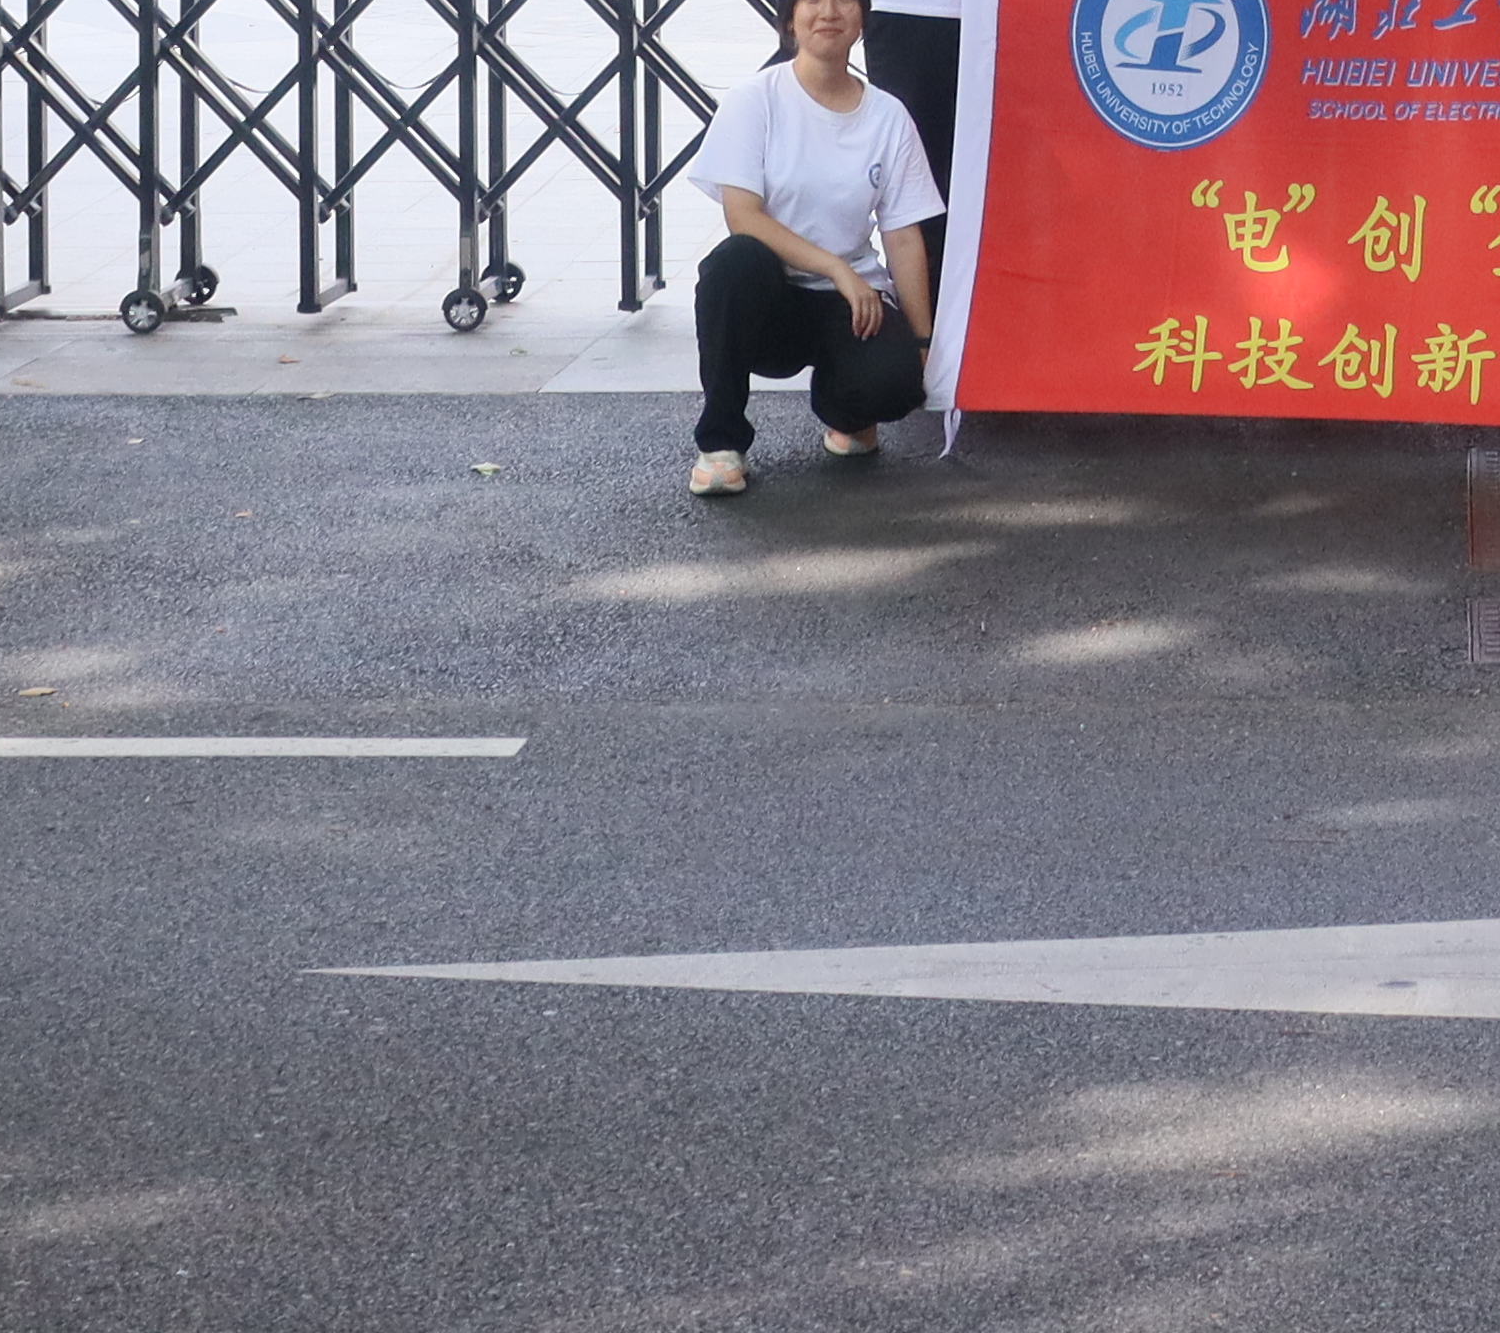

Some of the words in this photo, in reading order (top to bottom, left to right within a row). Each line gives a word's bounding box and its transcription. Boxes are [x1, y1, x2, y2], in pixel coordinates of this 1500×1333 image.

[1080, 31, 1101, 80] HUBEI
[1096, 81, 1170, 134] UNIVERSITY
[1171, 119, 1192, 134] OF
[1191, 41, 1260, 130] TECHNOLOGY
[1301, 58, 1398, 87] HUBEI
[1150, 82, 1184, 97] 1952
[1307, 98, 1388, 121] SCHOOL
[1394, 101, 1421, 121] OF
